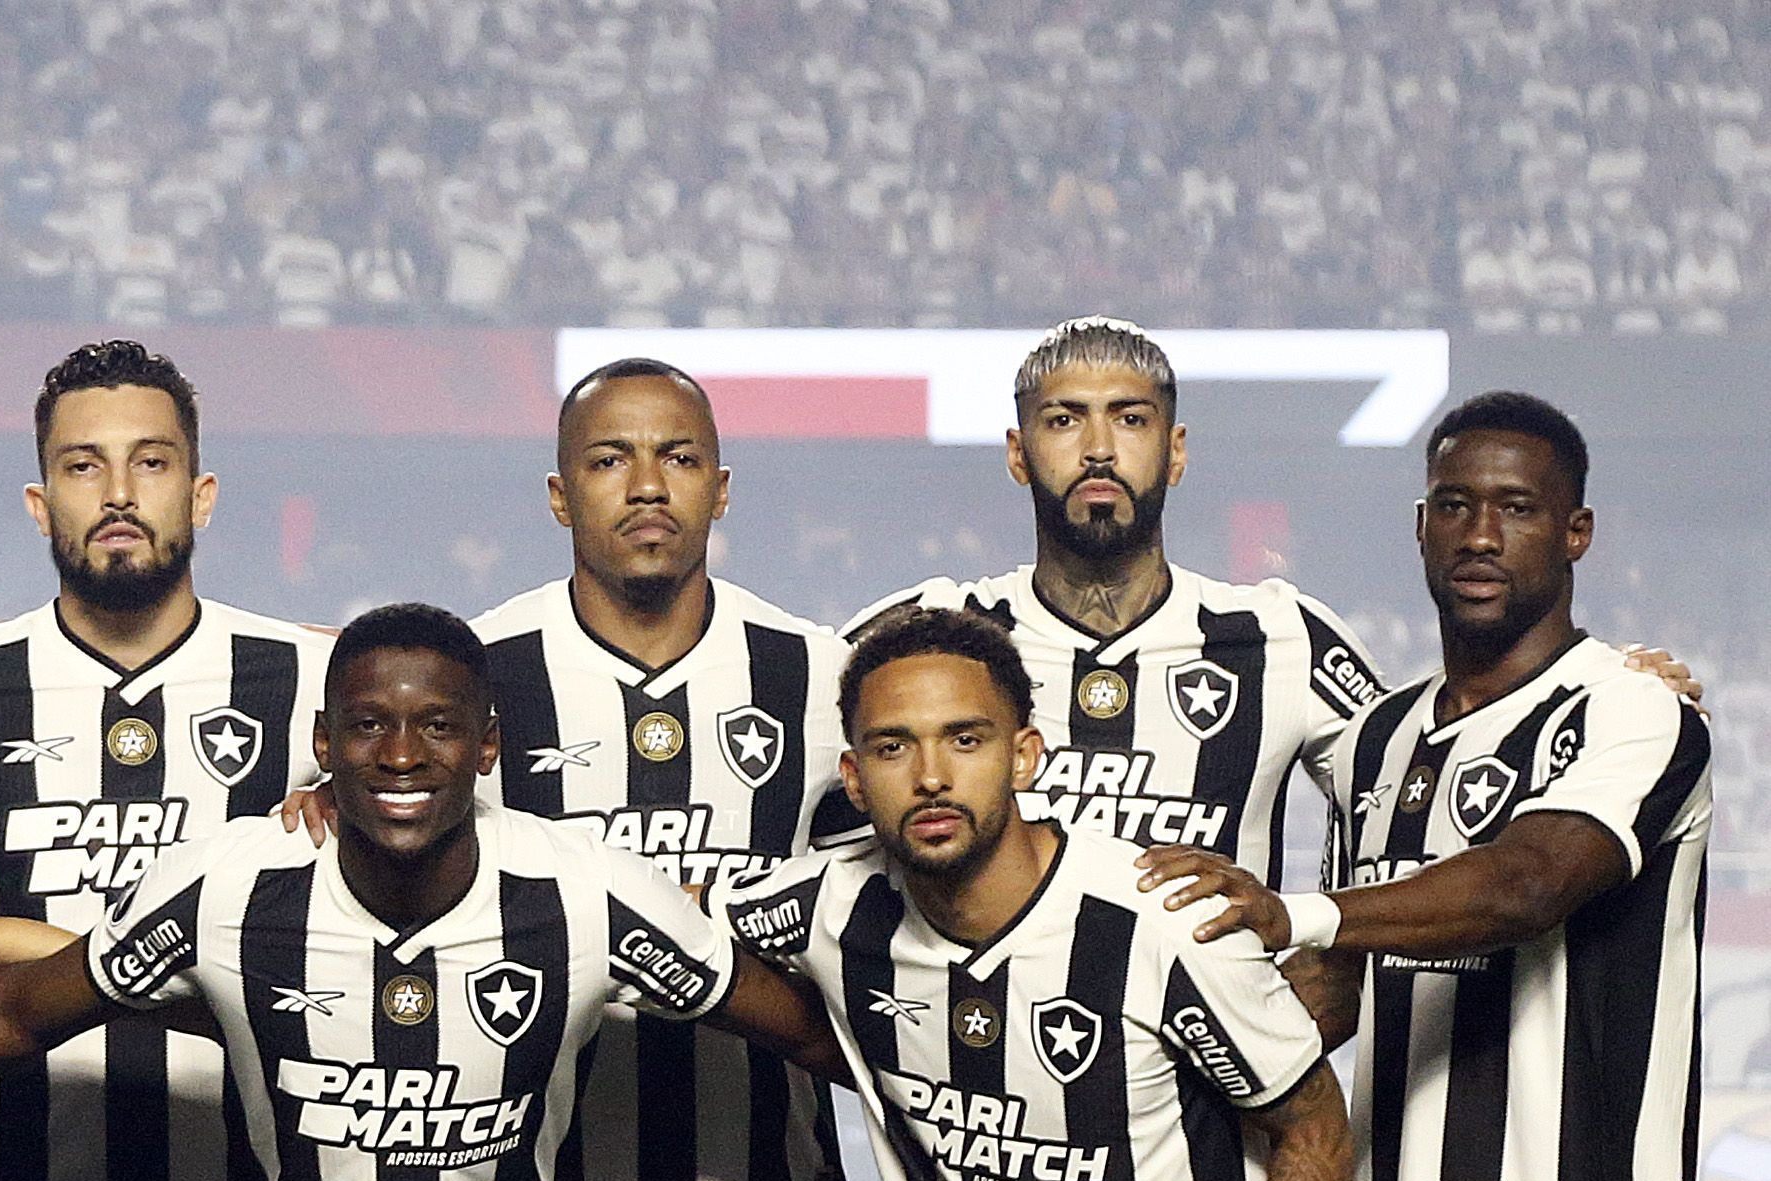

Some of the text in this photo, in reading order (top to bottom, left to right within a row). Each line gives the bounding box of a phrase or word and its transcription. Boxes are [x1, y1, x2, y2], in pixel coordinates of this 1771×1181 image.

[1034, 751, 1151, 796] ARI
[5, 801, 184, 852] PARI
[618, 928, 705, 998] Centrum
[1174, 1006, 1252, 1097] Centrum
[278, 1059, 454, 1108] PARI
[878, 1069, 1022, 1138] PARI
[298, 1093, 533, 1149] MATCH
[386, 1135, 520, 1167] APOSTAS ESPORTIVAS
